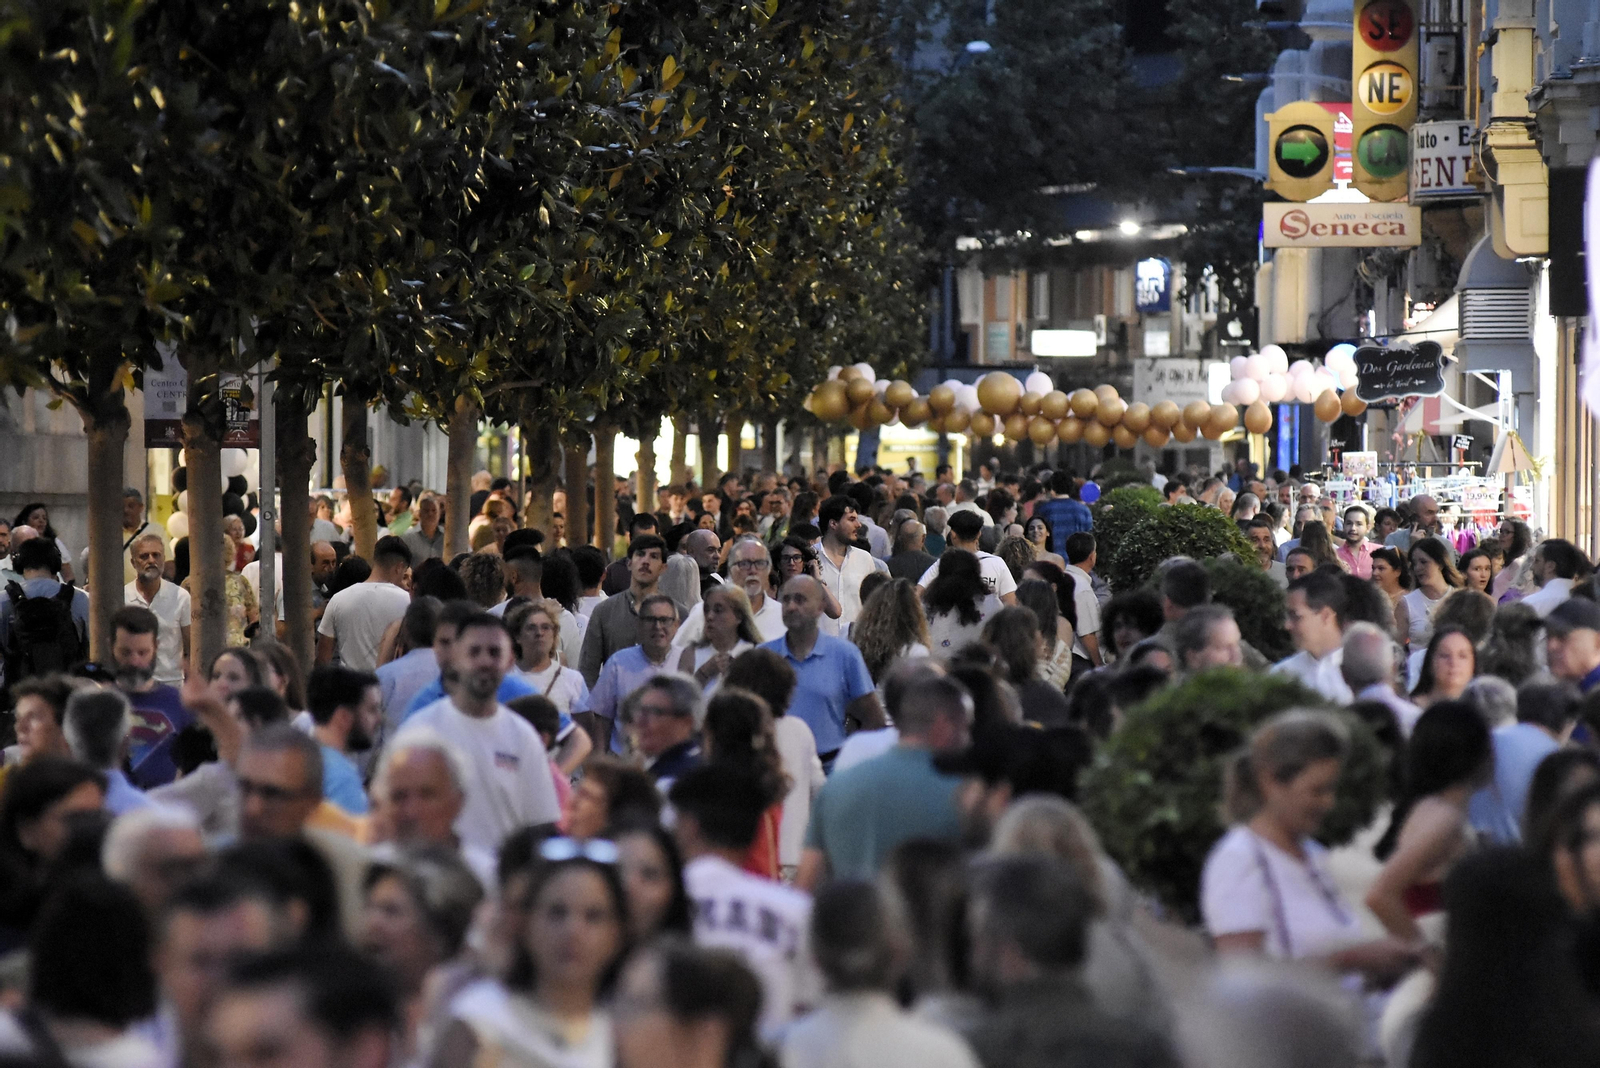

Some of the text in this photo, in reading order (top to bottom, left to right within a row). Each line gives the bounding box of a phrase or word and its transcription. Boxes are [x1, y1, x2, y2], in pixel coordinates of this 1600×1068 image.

[1368, 8, 1402, 40] SE
[1368, 72, 1402, 103] NE
[1367, 135, 1402, 166] CA
[1280, 208, 1407, 240] Seneca
[1362, 353, 1434, 377] Dos Gardenias
[151, 379, 178, 387] Centro
